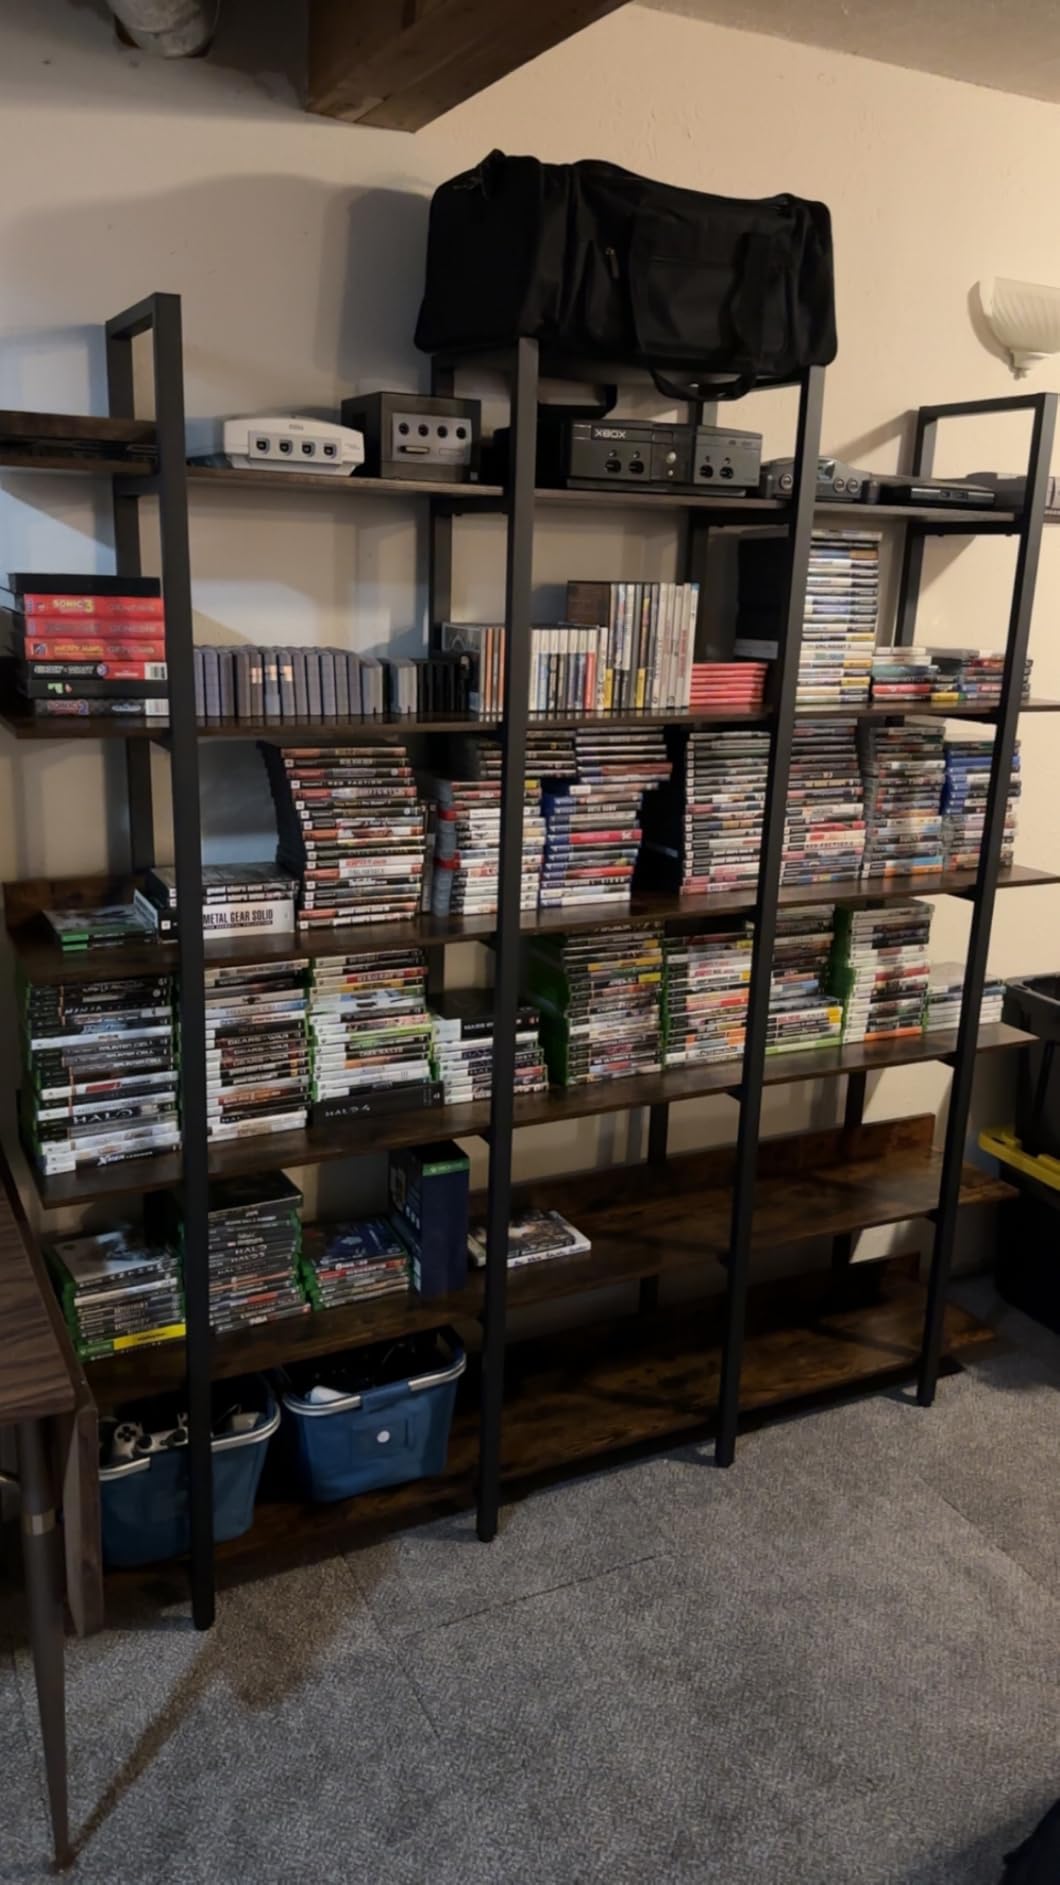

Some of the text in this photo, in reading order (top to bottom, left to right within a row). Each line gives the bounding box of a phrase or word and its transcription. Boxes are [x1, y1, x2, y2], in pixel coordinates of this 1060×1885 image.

[594, 429, 627, 439] XBOX
[53, 599, 83, 610] SONIC
[203, 908, 273, 925] METAL GEAR SOLID
[73, 1108, 133, 1125] HALO
[235, 1244, 268, 1255] HALO
